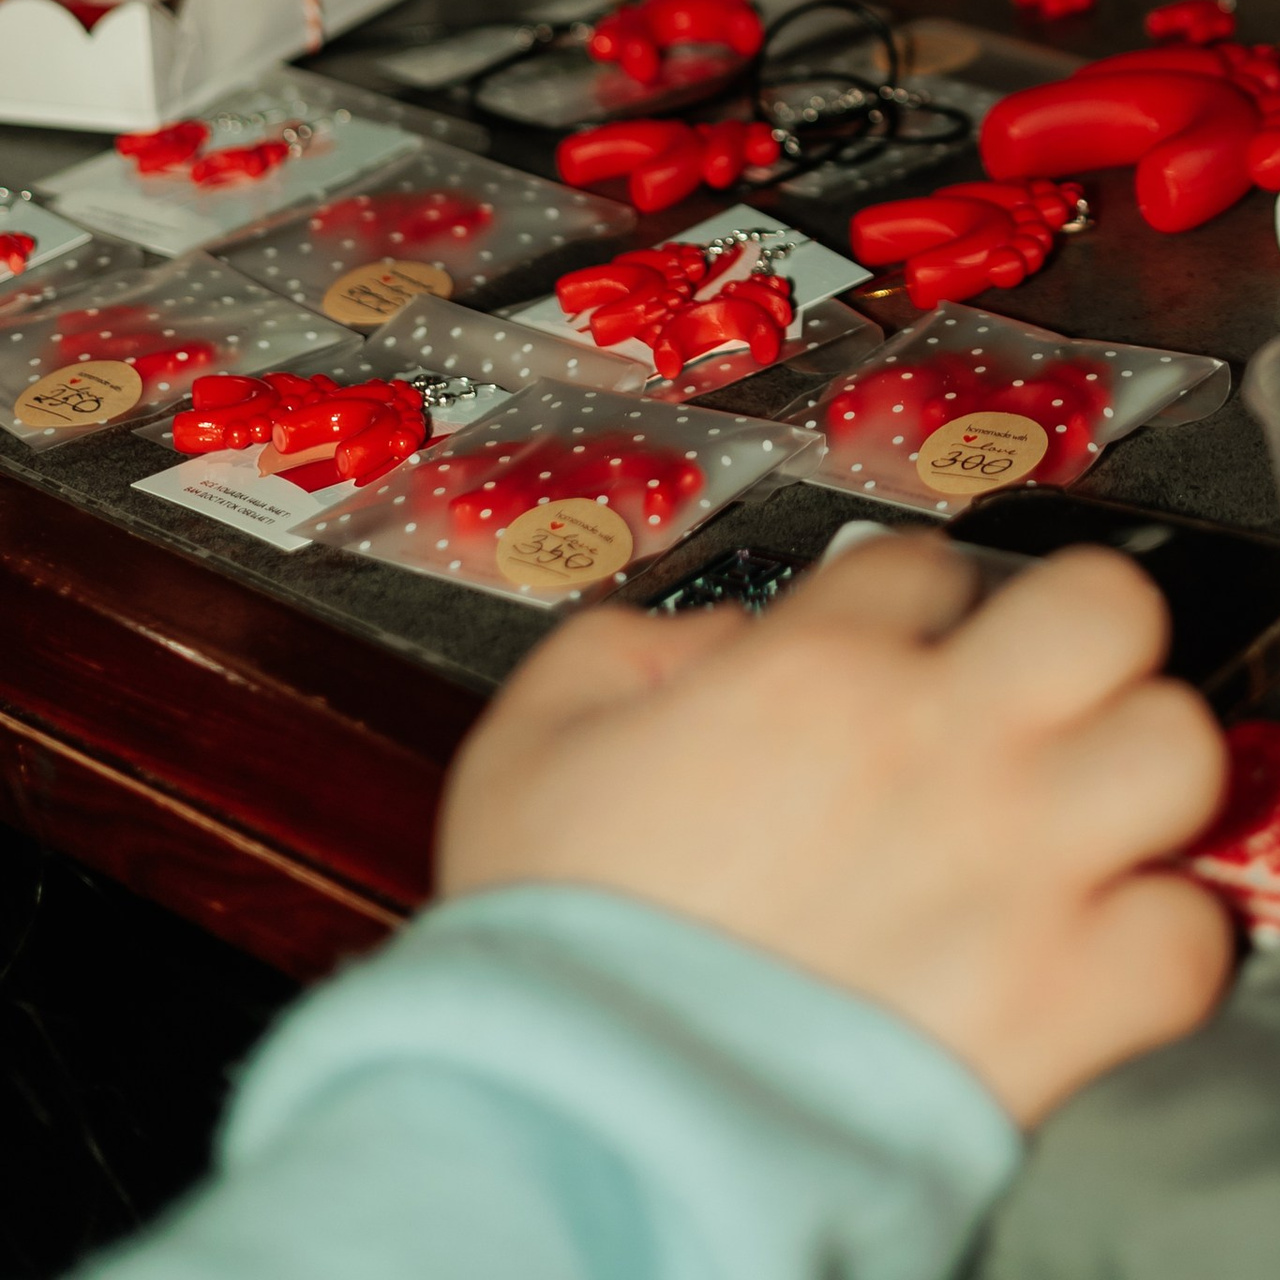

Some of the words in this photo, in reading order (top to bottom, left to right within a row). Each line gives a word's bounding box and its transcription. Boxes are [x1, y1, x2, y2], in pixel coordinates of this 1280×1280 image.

[965, 424, 1012, 439] homemade
[1012, 433, 1028, 442] with
[931, 451, 1013, 475] 300
[555, 509, 599, 535] homemade
[598, 531, 614, 544] with
[513, 534, 595, 570] 350
